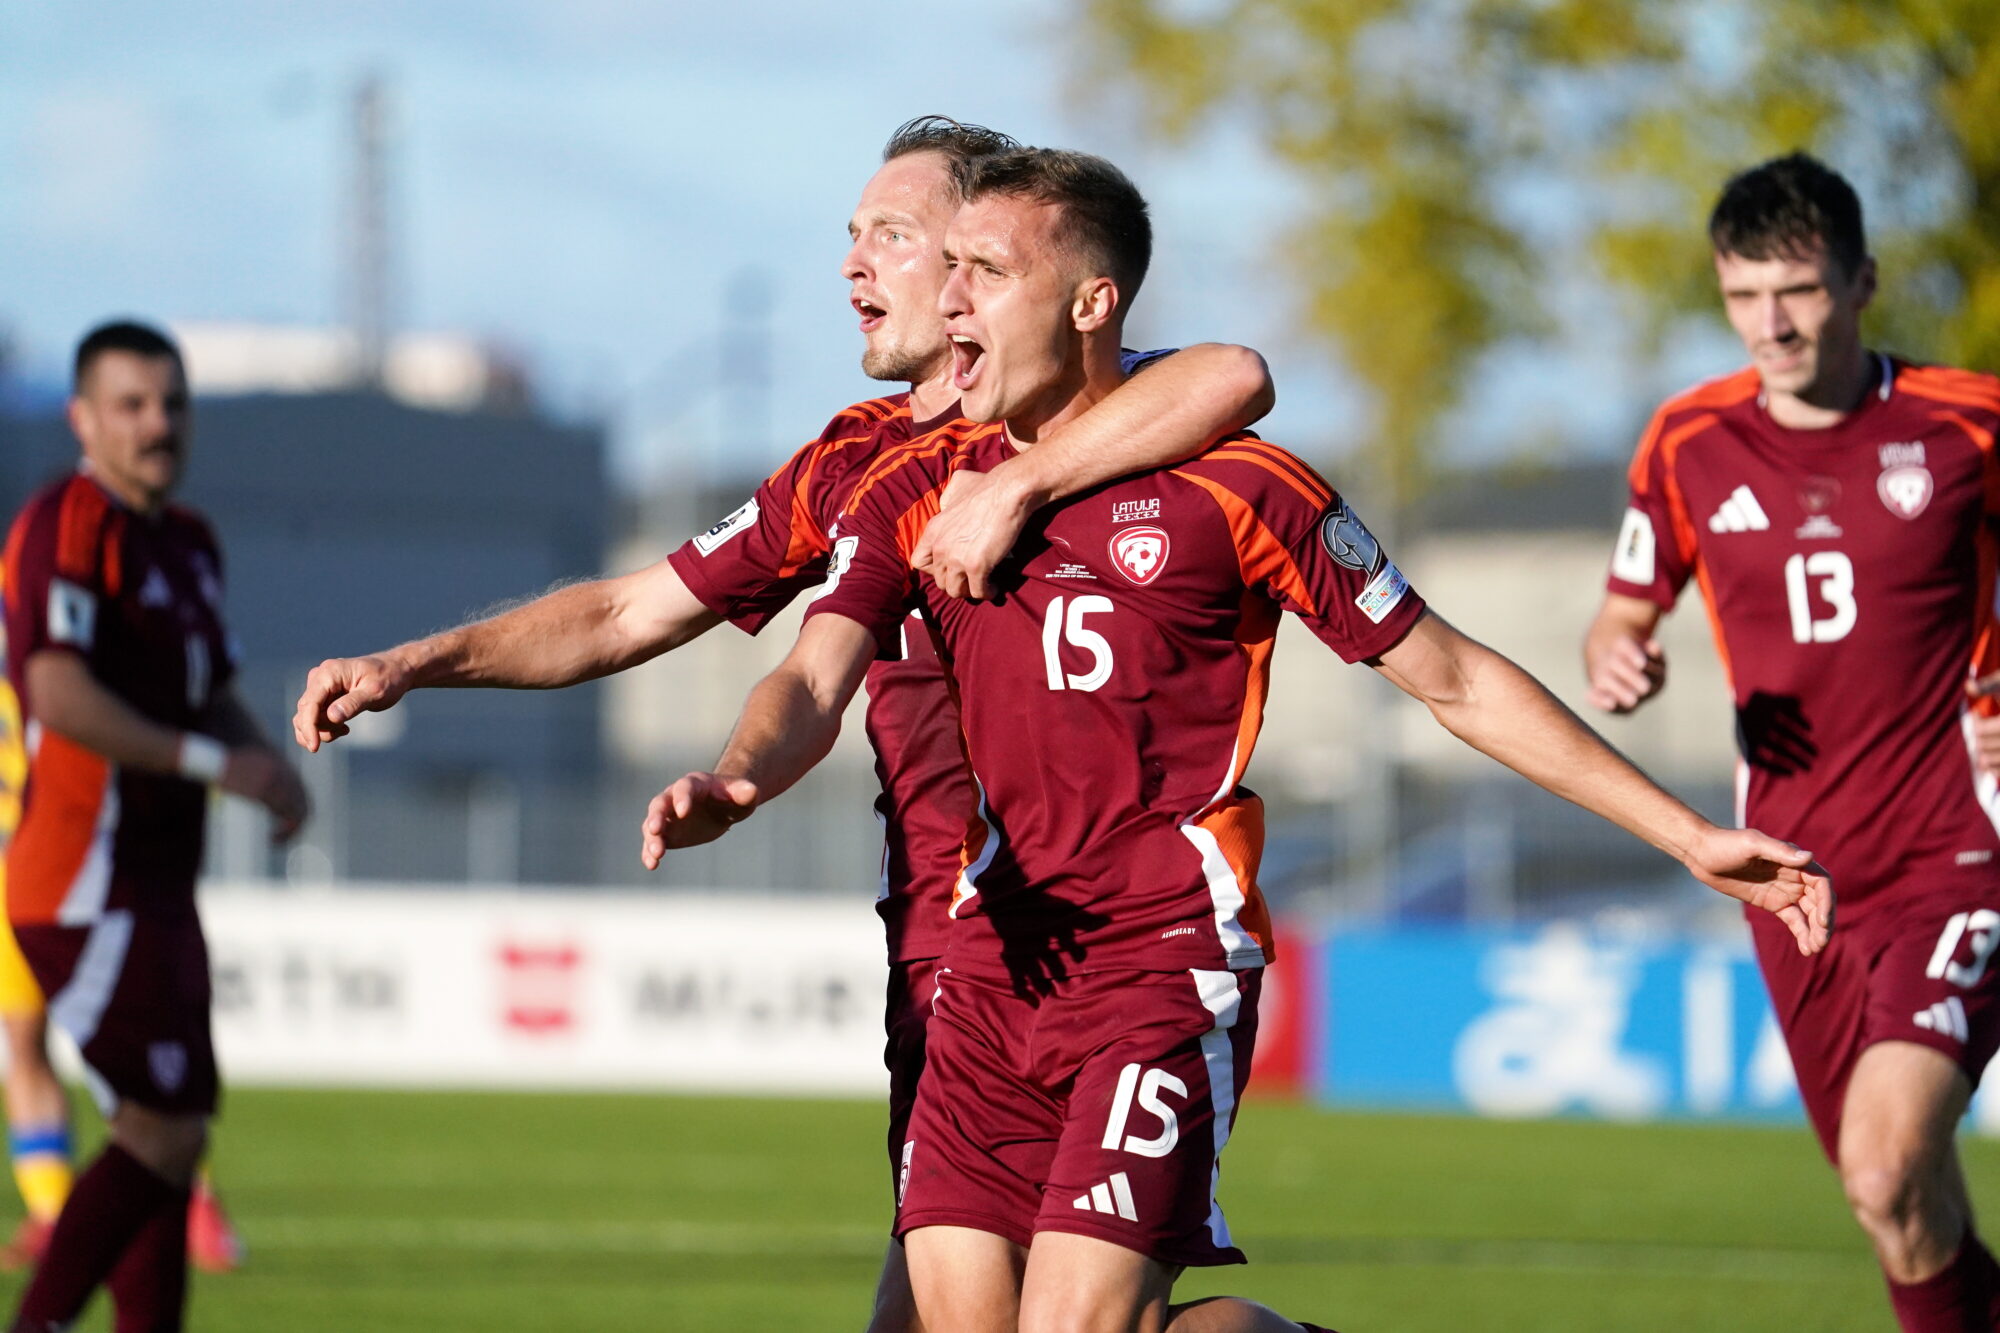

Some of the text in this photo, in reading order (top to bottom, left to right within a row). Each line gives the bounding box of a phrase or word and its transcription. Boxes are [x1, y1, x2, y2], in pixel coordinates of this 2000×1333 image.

[1112, 499, 1160, 514] LATVIJA
[1360, 591, 1372, 606] UEFA
[1785, 551, 1857, 643] 13
[1042, 595, 1114, 692] 15
[1925, 909, 2000, 988] 13
[1101, 1063, 1188, 1158] 15
